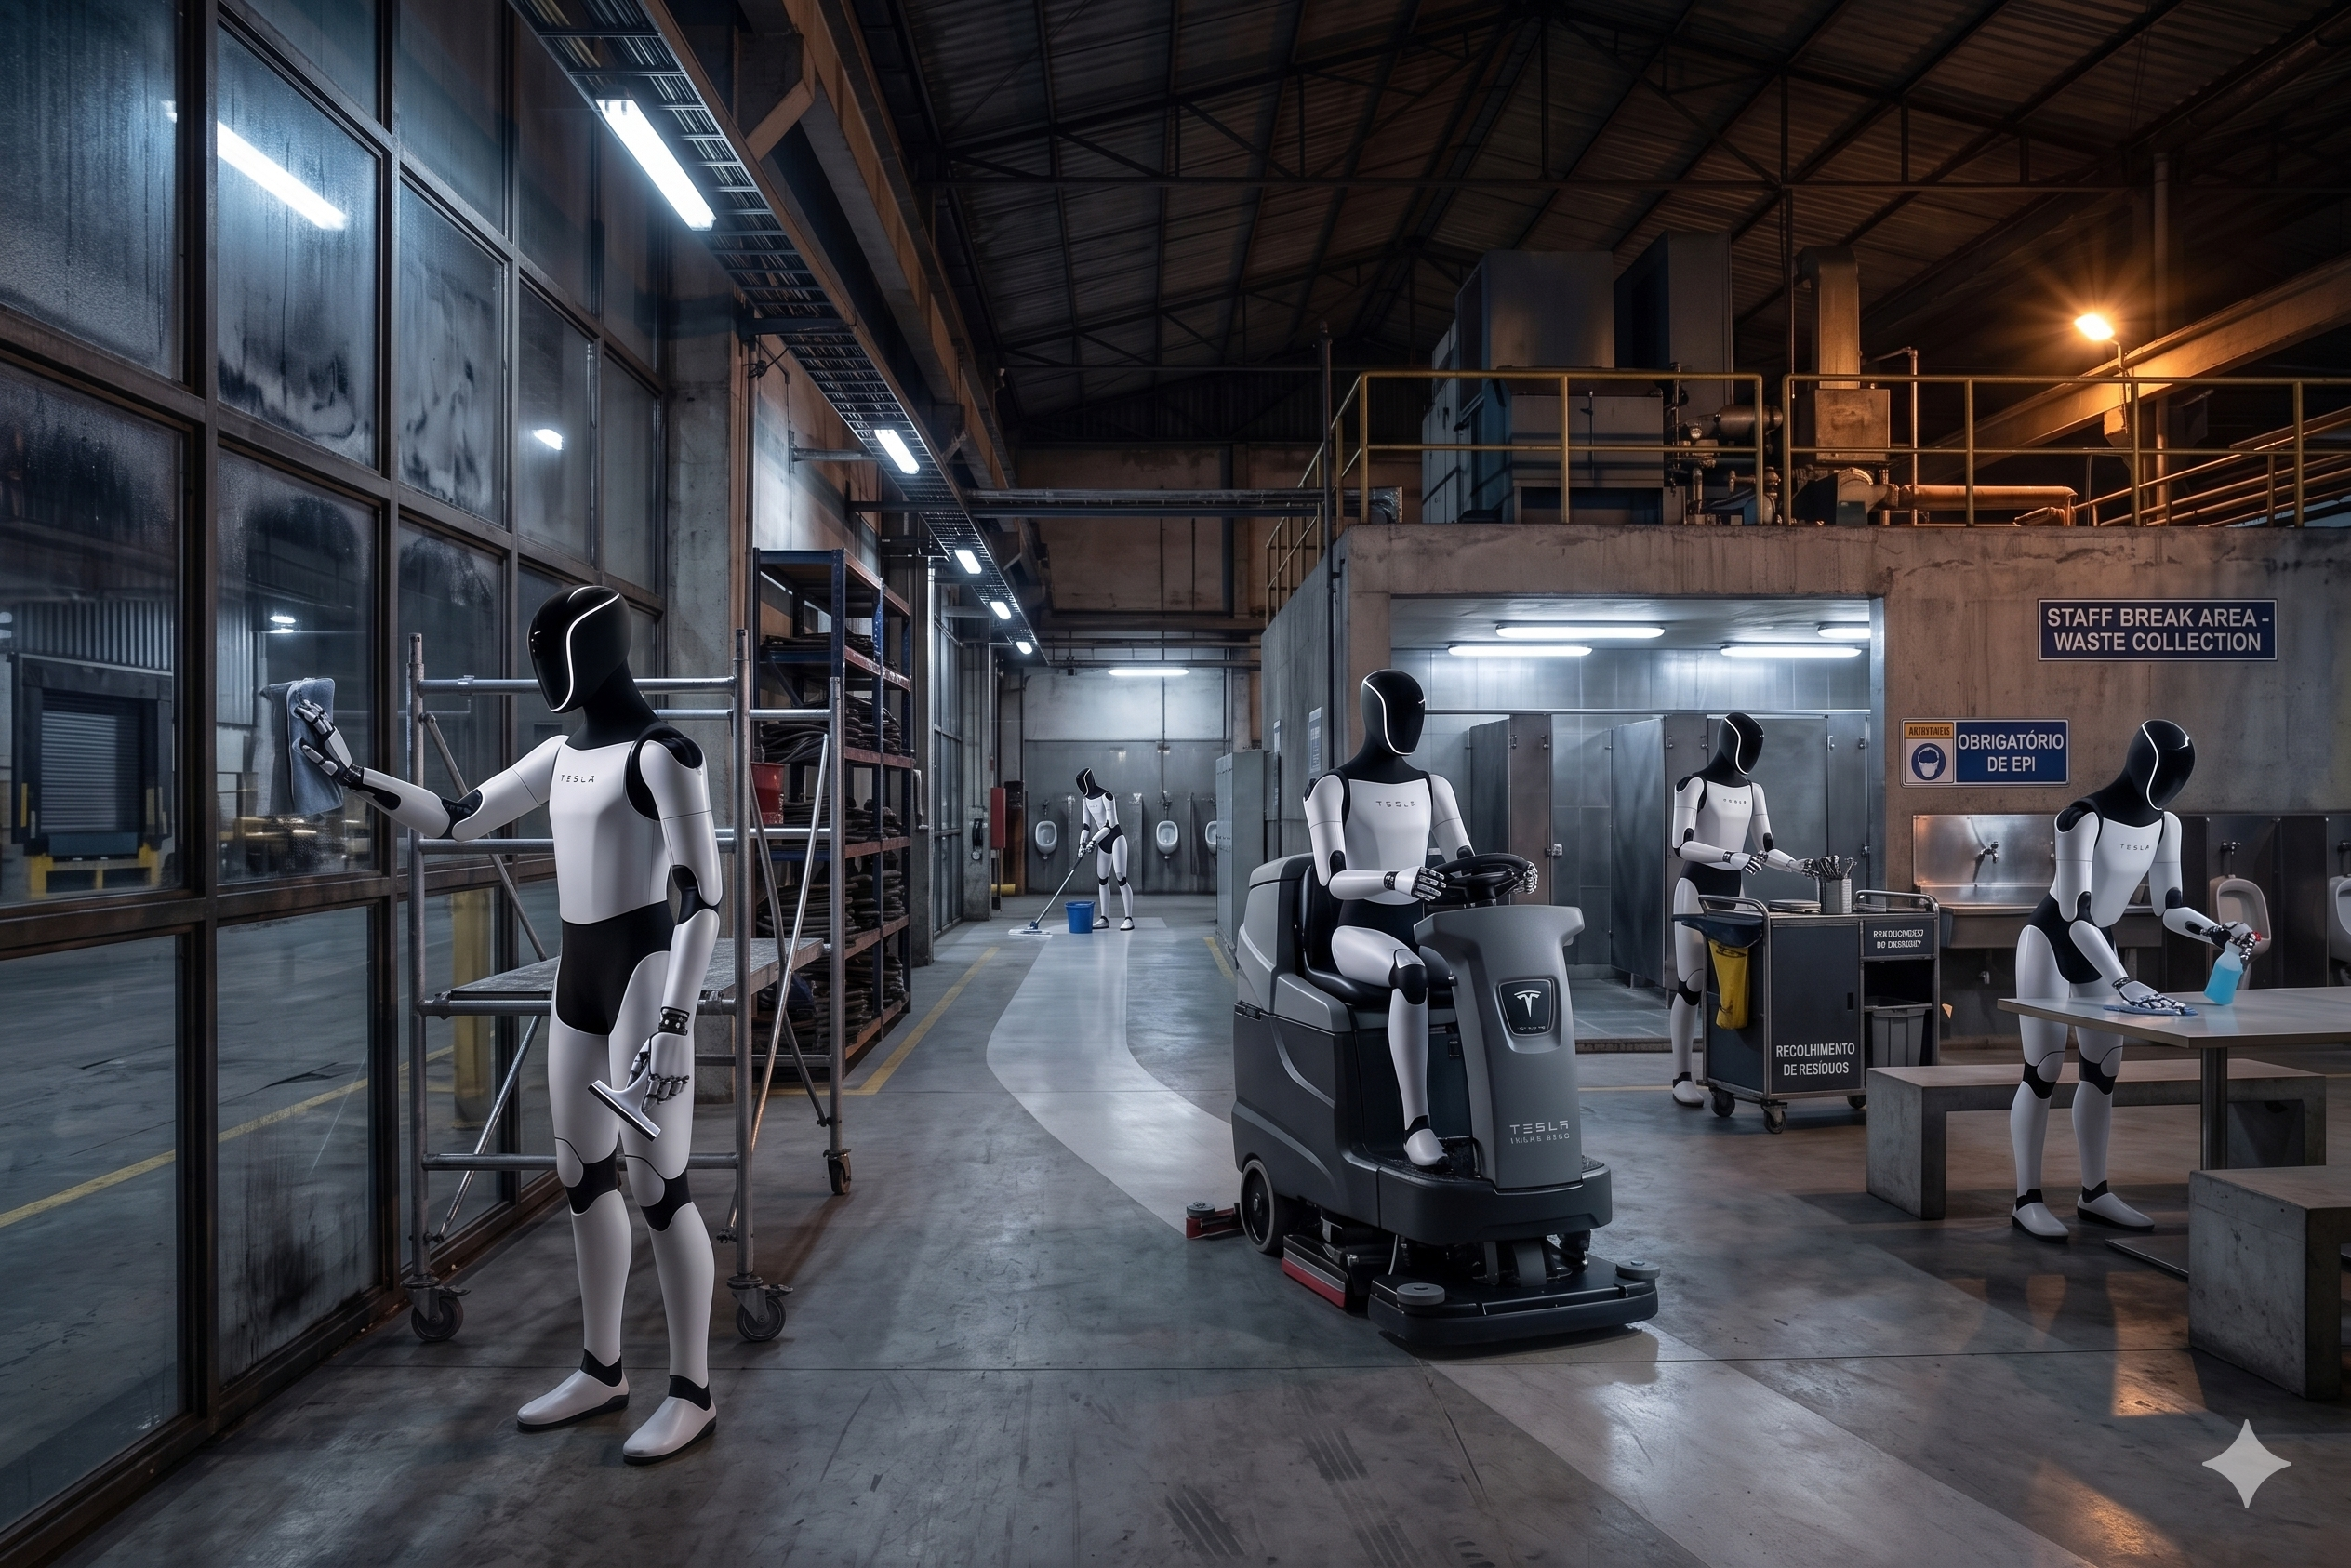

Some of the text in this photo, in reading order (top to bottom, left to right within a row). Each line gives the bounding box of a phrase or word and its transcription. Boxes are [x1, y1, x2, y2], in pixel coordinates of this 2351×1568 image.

[2047, 608, 2113, 627] STAFF
[2119, 608, 2194, 627] BREAK
[2198, 608, 2257, 627] AREA
[2053, 632, 2261, 651] WASTE COLLECTION
[1958, 729, 2065, 750] OBRIGATÓRIO
[1987, 756, 2036, 772] DE EPI
[560, 774, 595, 783] TESLA
[2120, 843, 2150, 851] TESLA
[1775, 1043, 1855, 1058] RECOLHIMENTO
[1784, 1060, 1850, 1076] DE RESÍDUOS
[1509, 1120, 1569, 1135] TESLA
